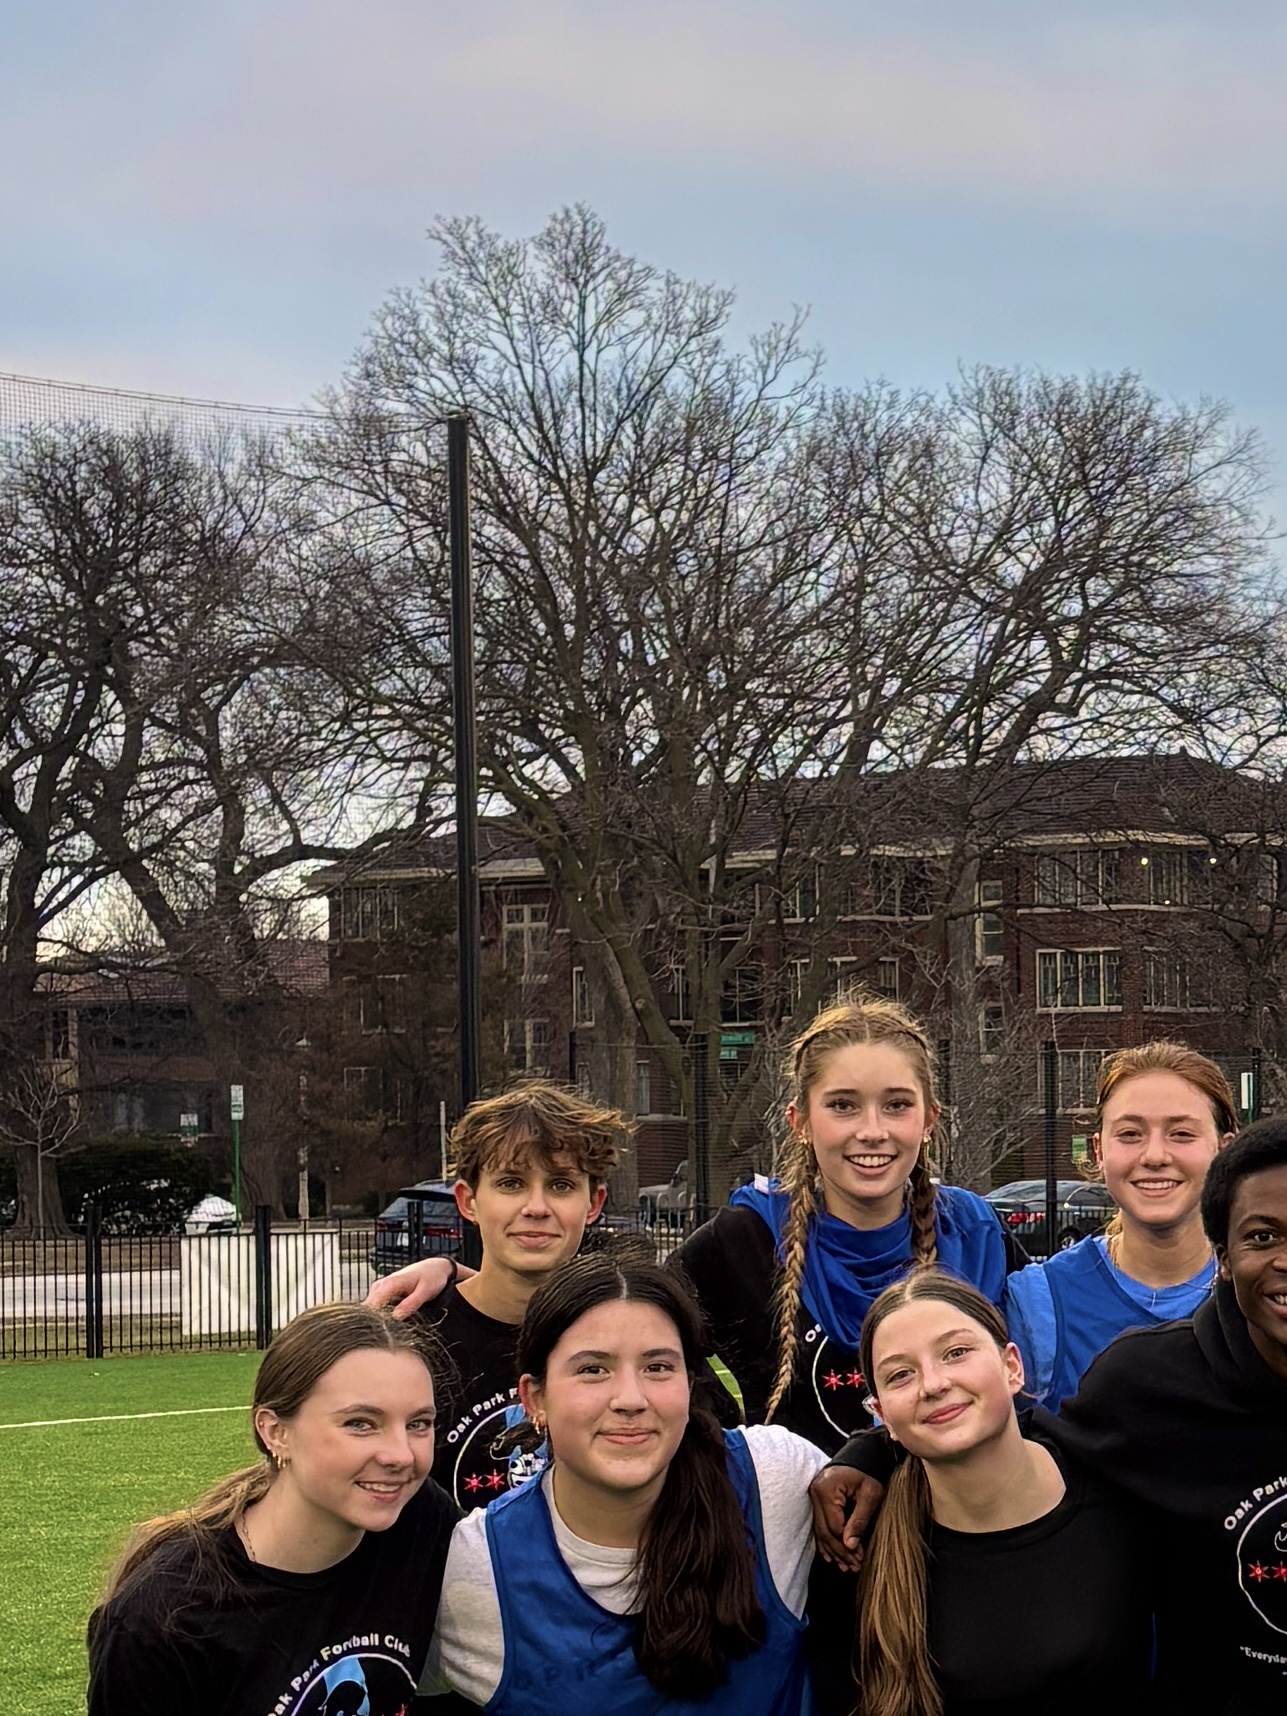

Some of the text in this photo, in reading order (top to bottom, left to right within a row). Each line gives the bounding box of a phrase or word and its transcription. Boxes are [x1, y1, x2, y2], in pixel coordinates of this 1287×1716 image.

[447, 1416, 472, 1443] Oak
[472, 1393, 505, 1416] Park
[1224, 1499, 1253, 1530] Oak
